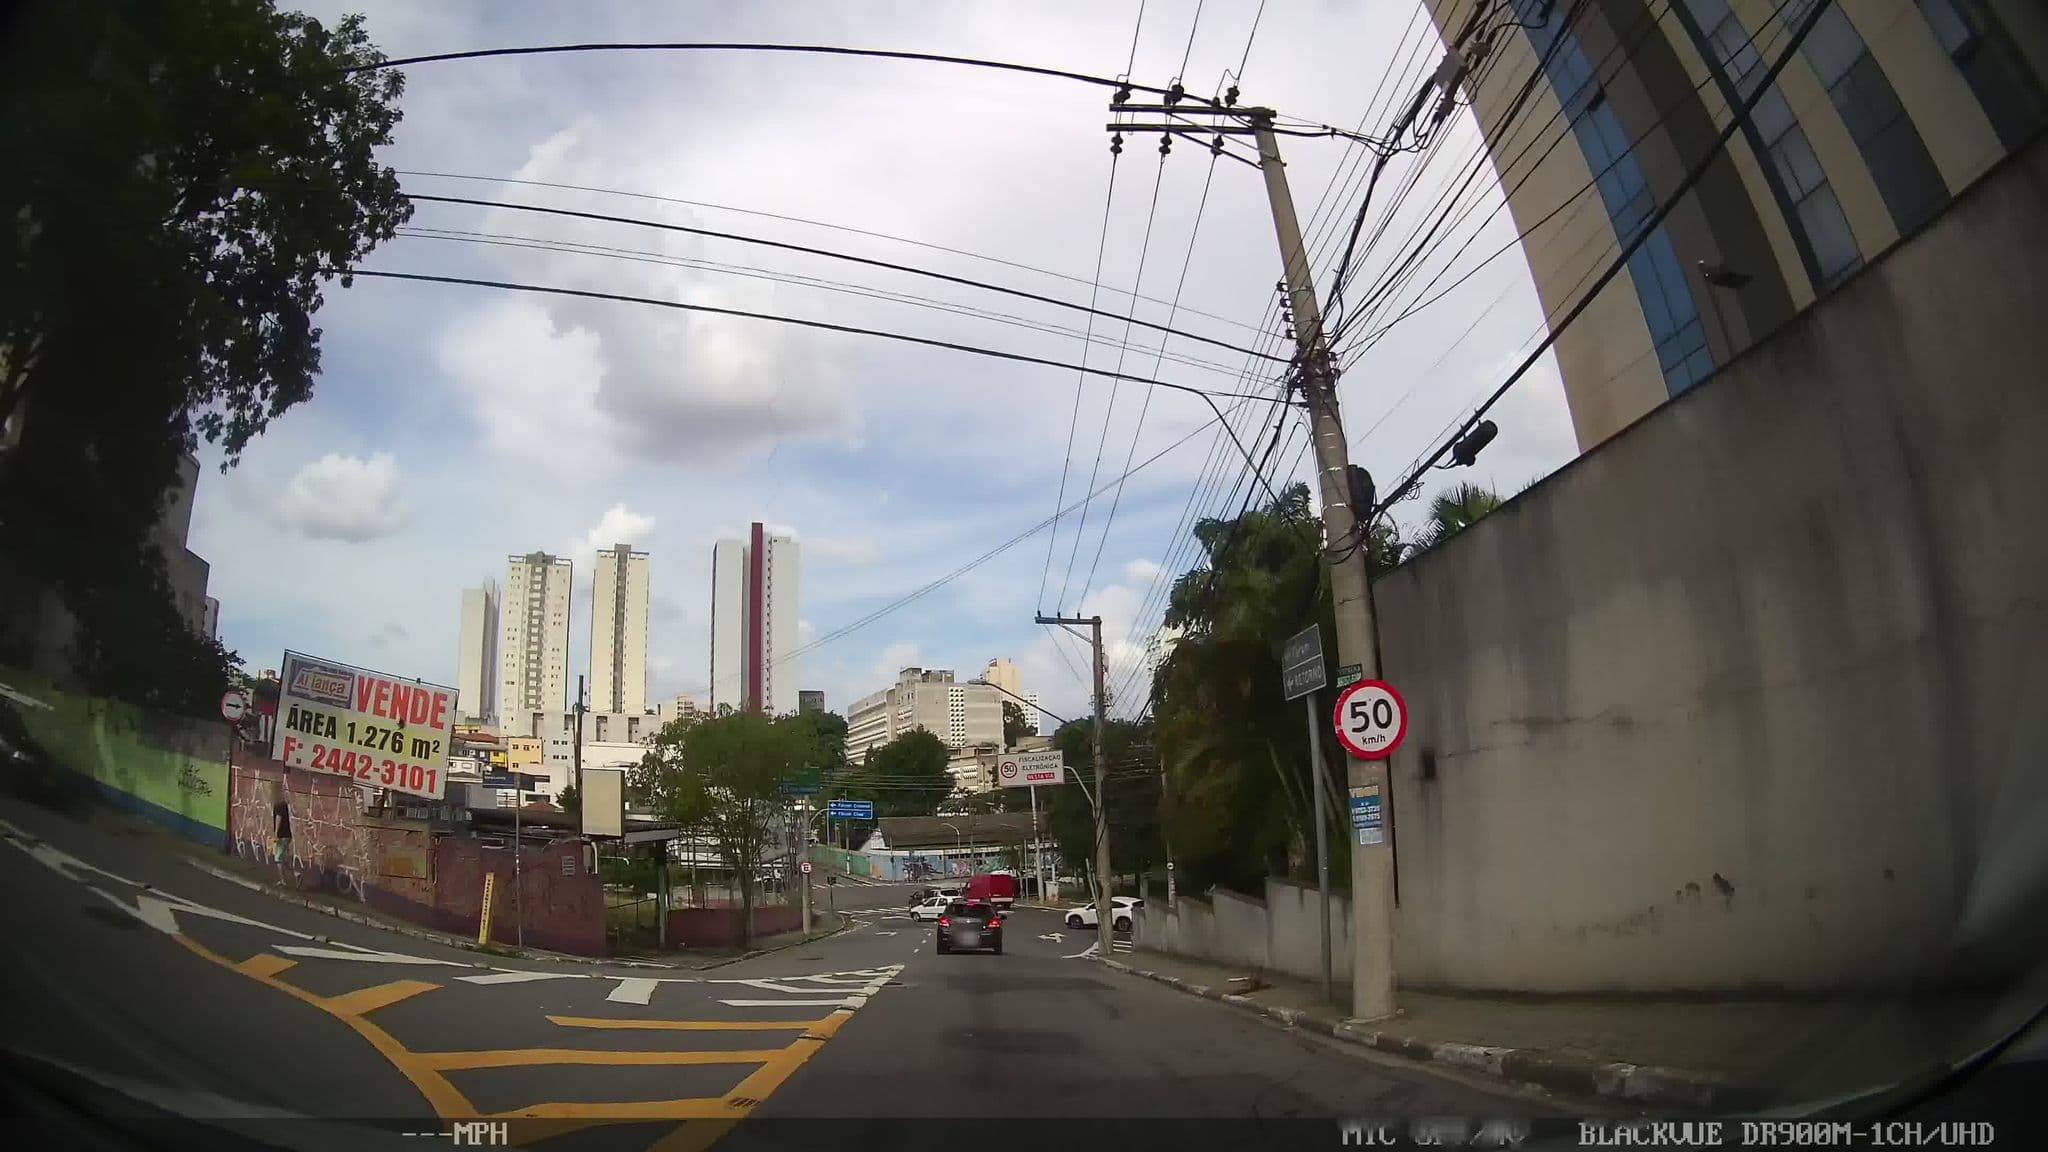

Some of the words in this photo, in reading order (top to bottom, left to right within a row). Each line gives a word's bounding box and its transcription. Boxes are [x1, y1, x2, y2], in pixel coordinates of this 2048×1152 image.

[357, 674, 448, 730] VENDE
[1351, 698, 1392, 733] 50
[286, 703, 336, 740] ÁREA
[347, 722, 404, 754] 1.276
[411, 738, 440, 759] m²
[1361, 734, 1386, 746] km/h
[283, 736, 303, 764] F:
[311, 743, 436, 794] 2442-3101
[1004, 765, 1014, 773] 50
